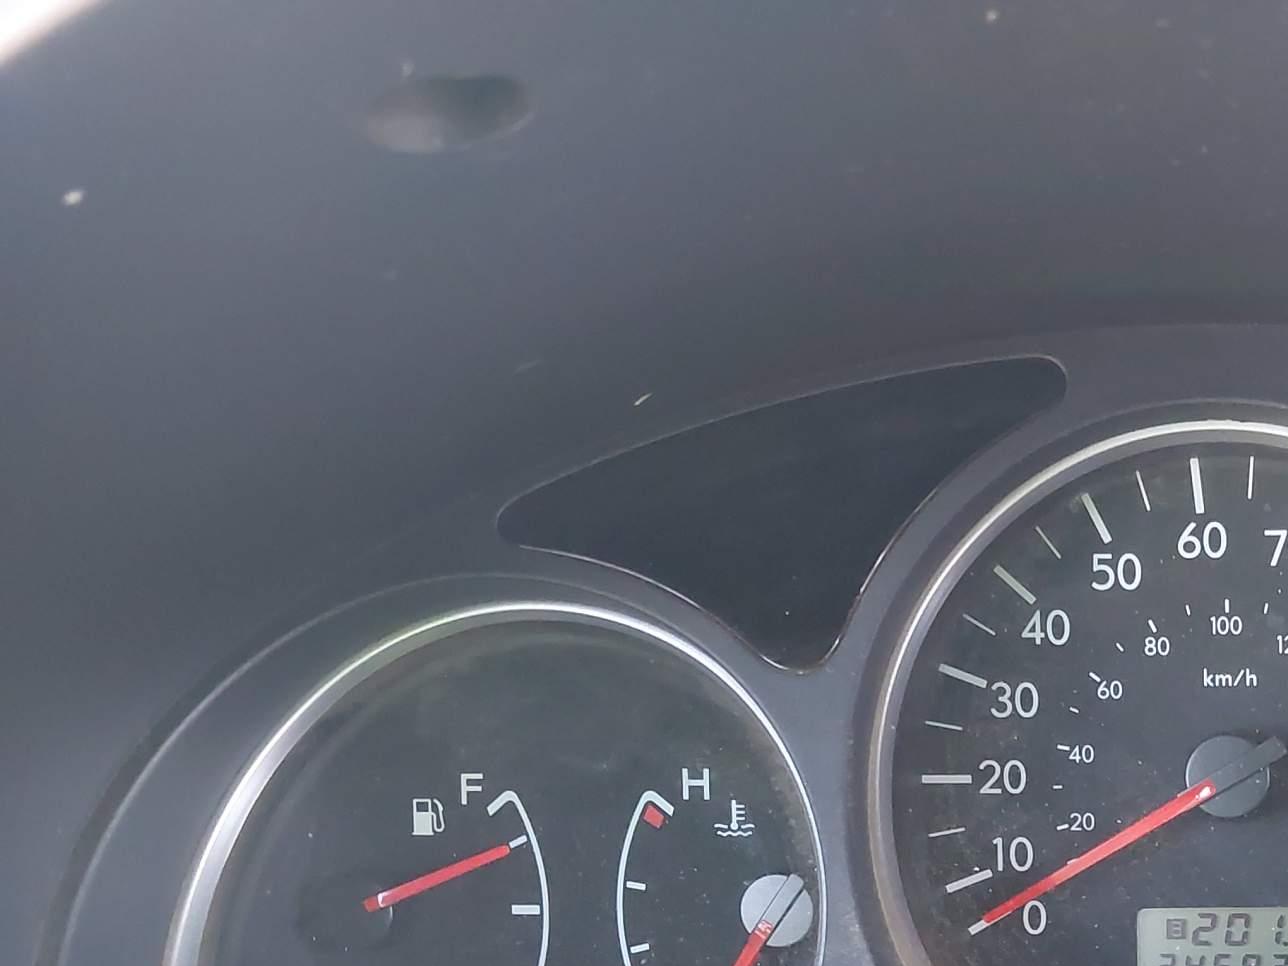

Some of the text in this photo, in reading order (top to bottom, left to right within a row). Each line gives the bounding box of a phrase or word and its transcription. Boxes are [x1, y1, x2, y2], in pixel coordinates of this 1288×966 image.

[1176, 522, 1229, 559] 60
[1091, 553, 1142, 591] 50
[1021, 609, 1071, 646] 40
[1209, 615, 1244, 636] 100
[1143, 636, 1171, 657] 80
[1096, 679, 1124, 700] 60
[1201, 668, 1258, 688] km/h
[990, 681, 1039, 719] 30
[1069, 744, 1095, 764] 40
[460, 772, 484, 806] F
[681, 767, 710, 800] H
[978, 760, 1027, 794] 20
[1070, 812, 1096, 832] 20
[991, 835, 1034, 872] 10
[1022, 899, 1048, 935] 0
